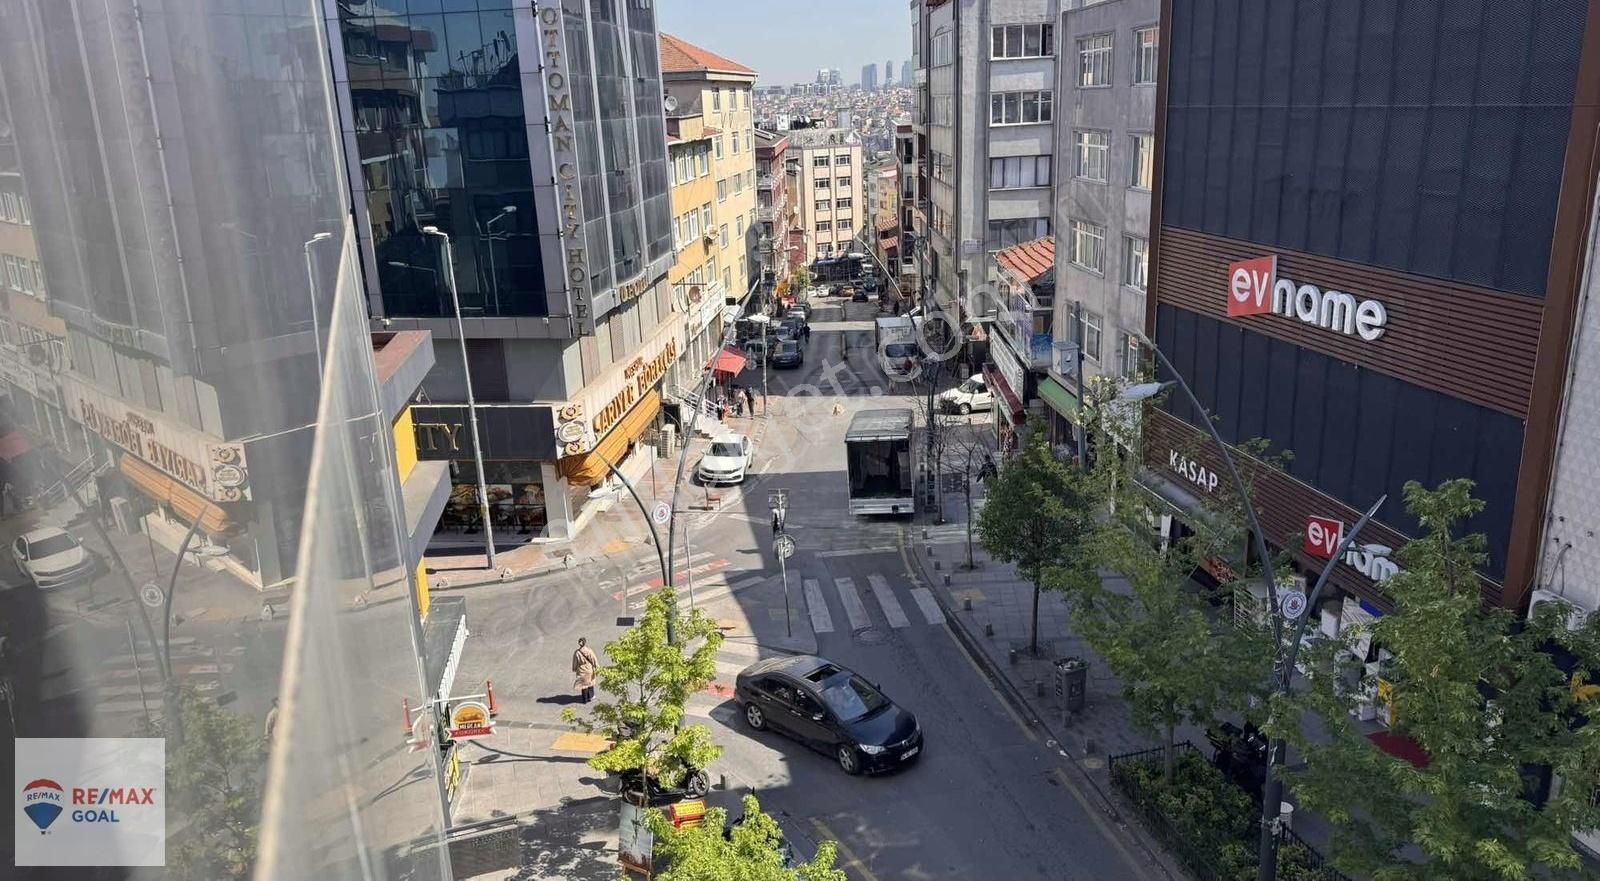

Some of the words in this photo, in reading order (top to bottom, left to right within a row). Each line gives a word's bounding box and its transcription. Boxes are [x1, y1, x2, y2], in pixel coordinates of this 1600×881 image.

[541, 7, 574, 152] OTTOMAN
[568, 248, 591, 337] HOTEL
[1170, 449, 1218, 492] KASAP
